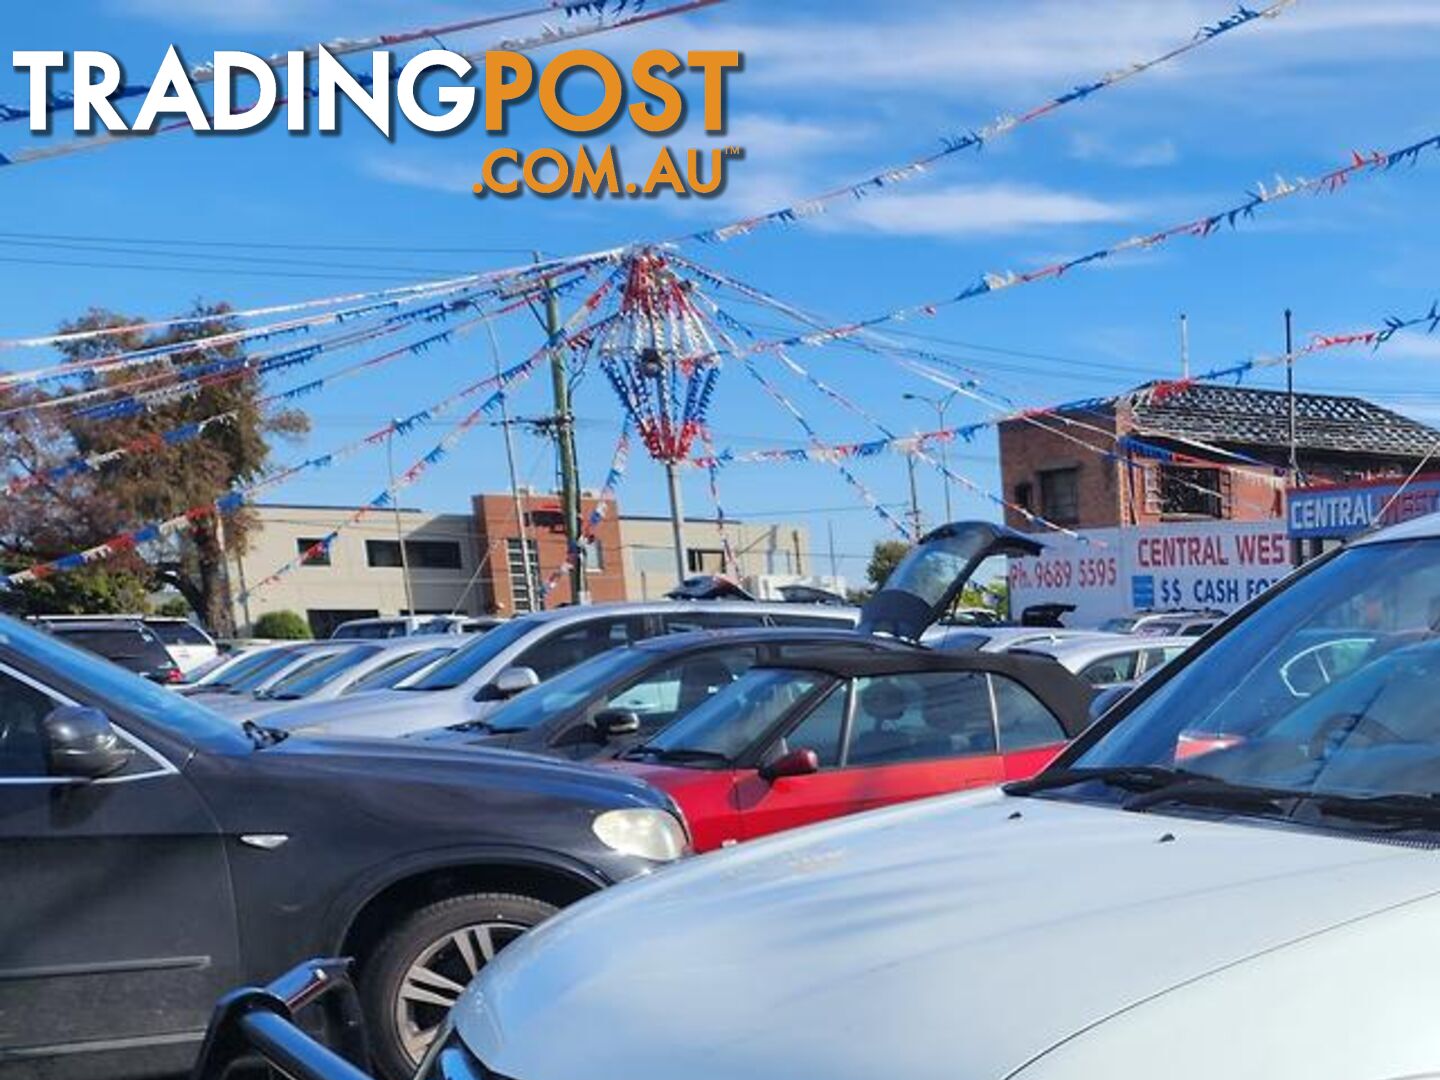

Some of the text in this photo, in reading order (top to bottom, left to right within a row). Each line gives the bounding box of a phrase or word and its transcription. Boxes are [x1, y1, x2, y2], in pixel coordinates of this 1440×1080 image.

[1291, 493, 1374, 530] CENTRAL
[1137, 536, 1229, 567] CENTRAL
[1034, 560, 1072, 588] 9689
[1079, 557, 1116, 587] 5595
[1193, 578, 1239, 603] CASH
